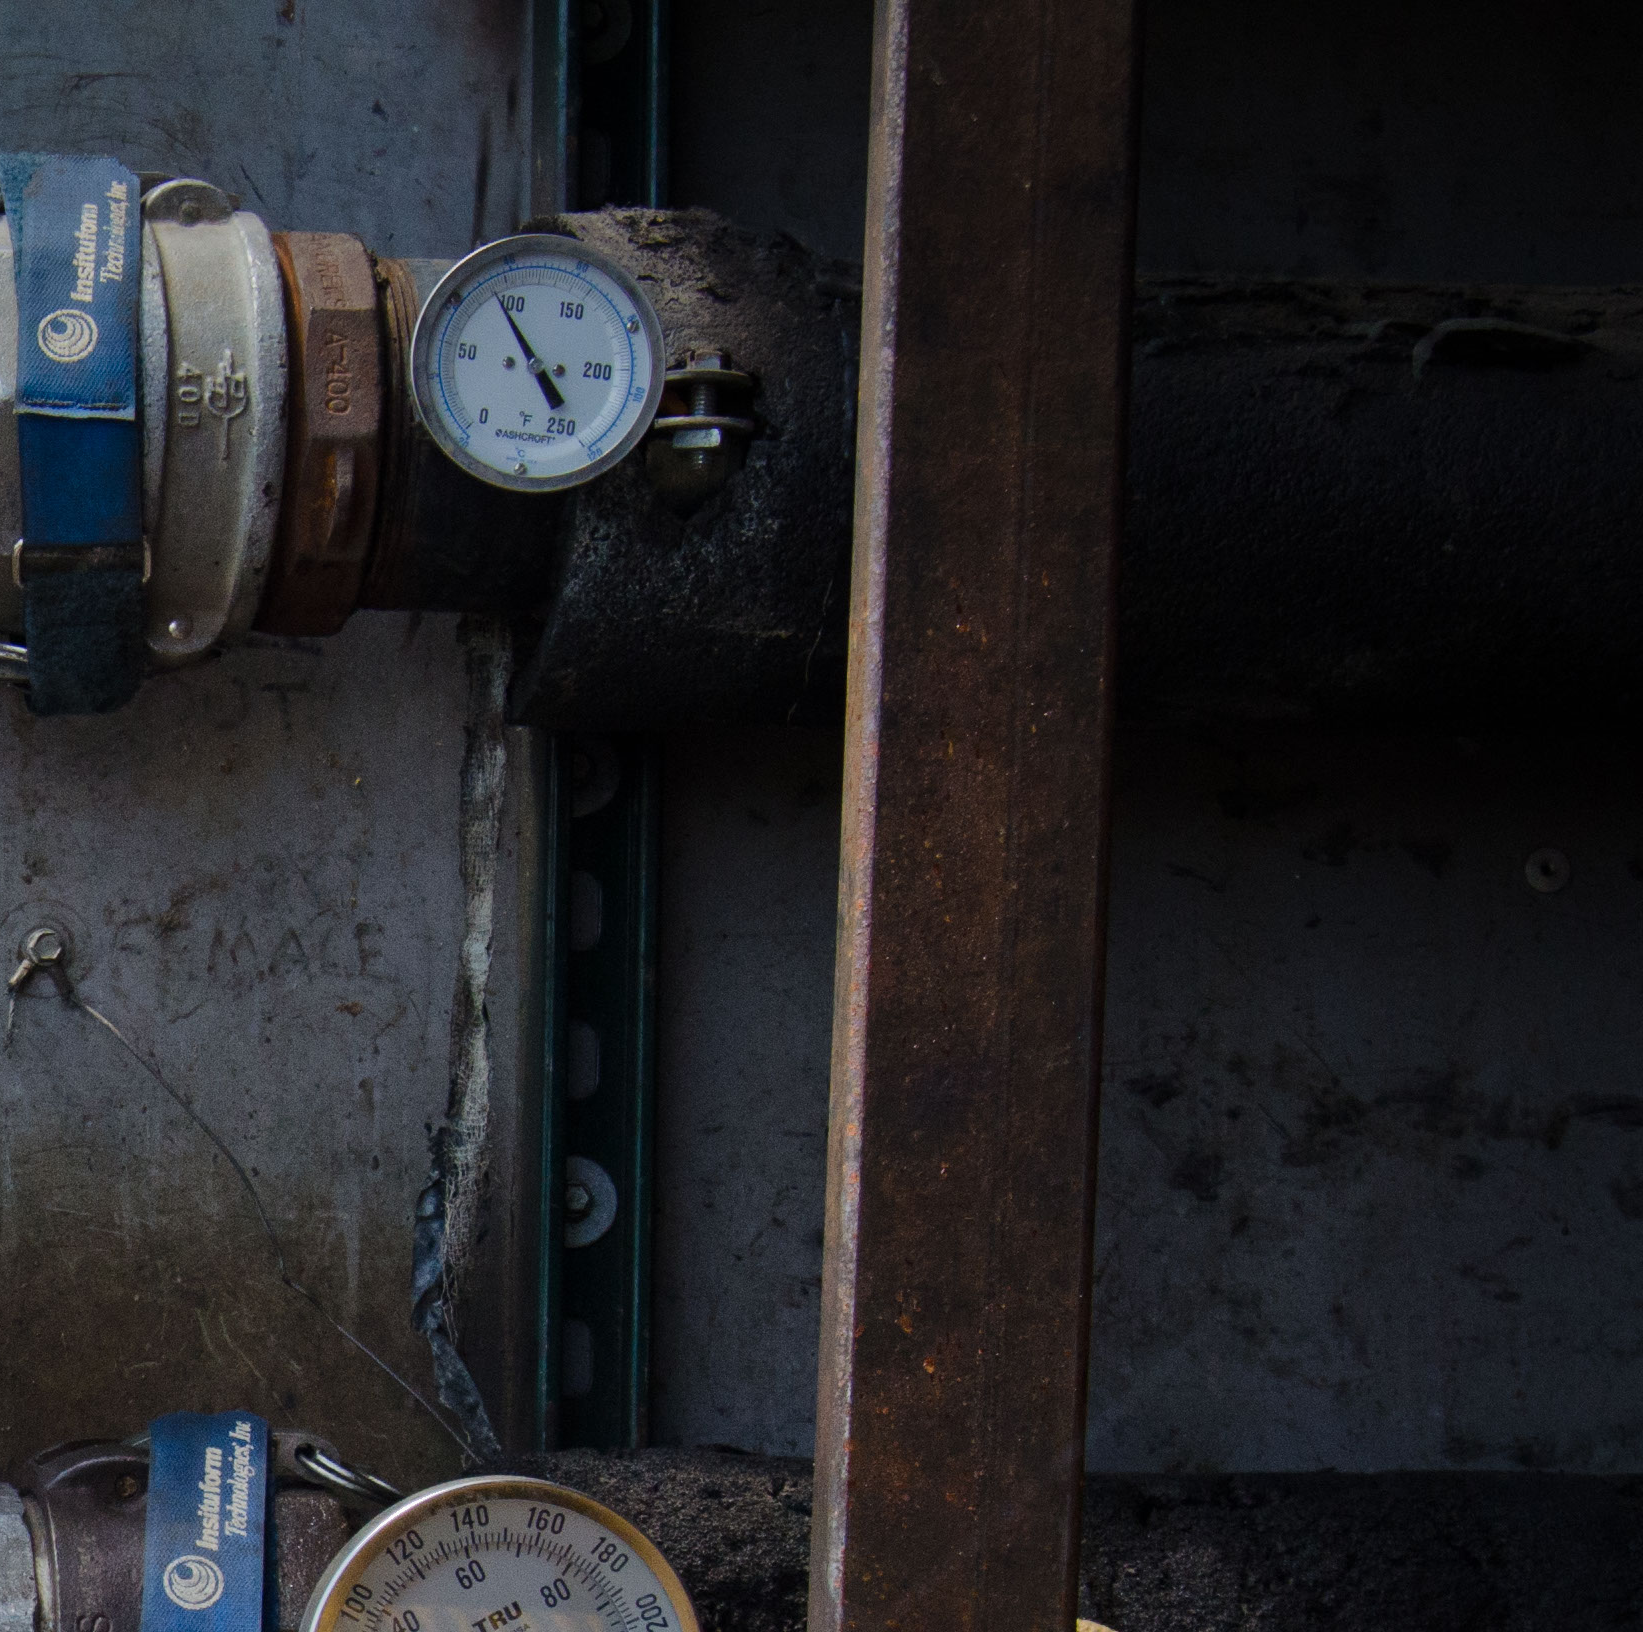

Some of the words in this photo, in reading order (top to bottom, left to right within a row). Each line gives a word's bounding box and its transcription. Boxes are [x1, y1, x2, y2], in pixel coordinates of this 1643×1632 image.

[559, 301, 585, 320] 150
[458, 343, 478, 360] 50
[582, 362, 612, 381] 200
[479, 407, 489, 425] 0
[546, 417, 576, 436] 250
[196, 1446, 223, 1551] Insituform
[450, 1505, 490, 1533] 140
[527, 1506, 565, 1535] 160
[385, 1529, 424, 1566] 120
[590, 1536, 629, 1574] 180
[455, 1559, 487, 1590] 60
[340, 1583, 373, 1623] 100
[539, 1578, 572, 1609] 80
